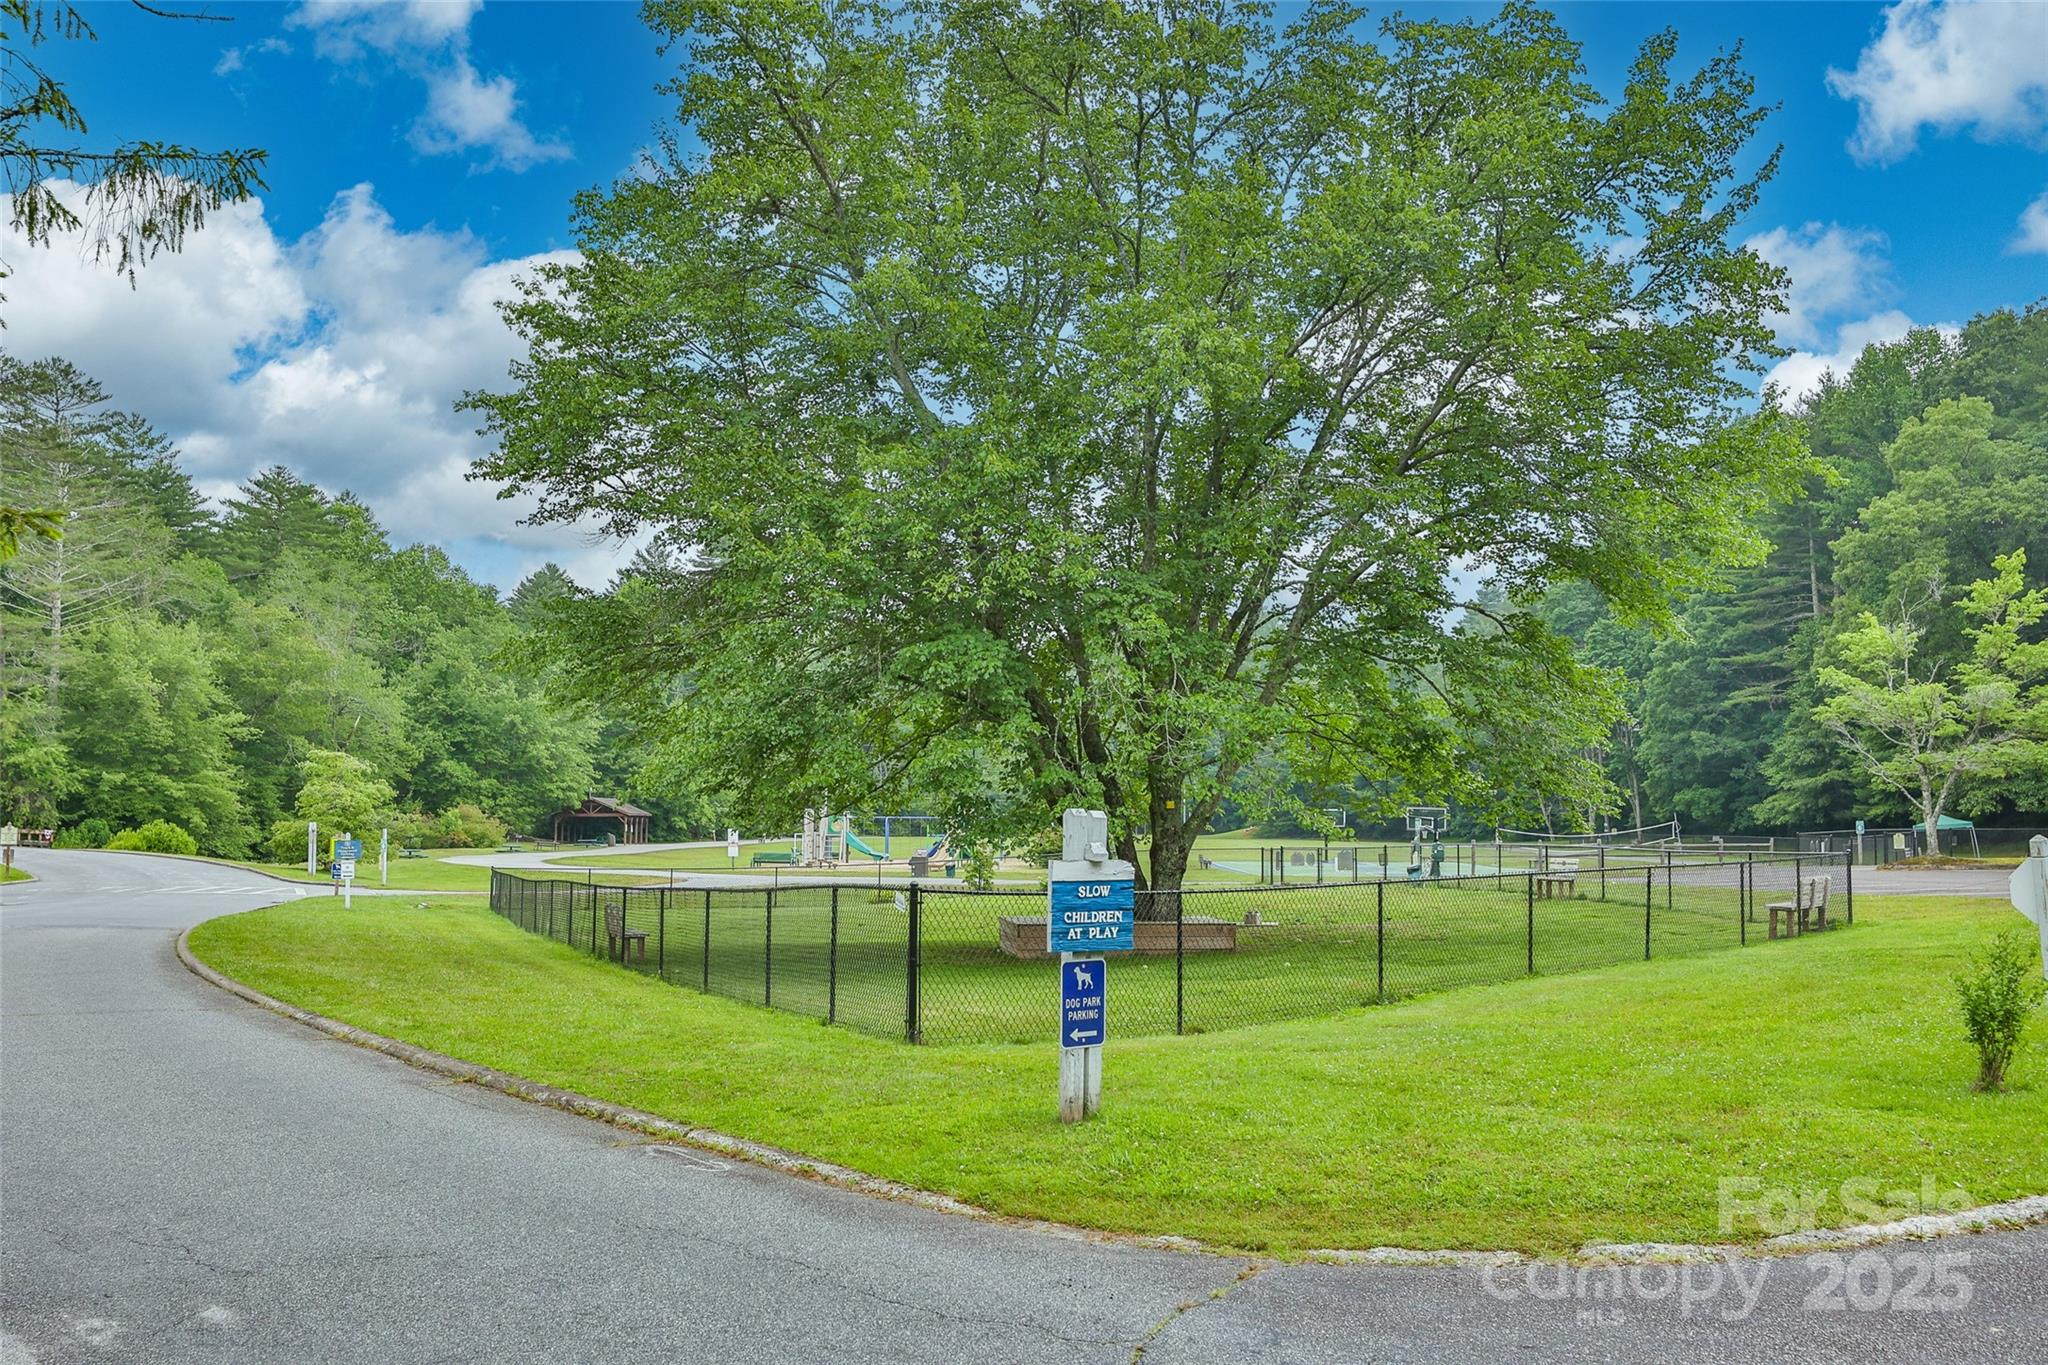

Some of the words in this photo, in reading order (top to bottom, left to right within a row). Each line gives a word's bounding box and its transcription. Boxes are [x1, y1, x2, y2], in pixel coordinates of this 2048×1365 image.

[1078, 885, 1111, 898] SLOW
[1064, 911, 1123, 923] CHILDREN
[1067, 928, 1083, 939] AT
[1089, 927, 1119, 938] PLAY
[1065, 998, 1081, 1009] DOG
[1082, 996, 1102, 1008] PARK
[1068, 1009, 1099, 1021] PARKING
